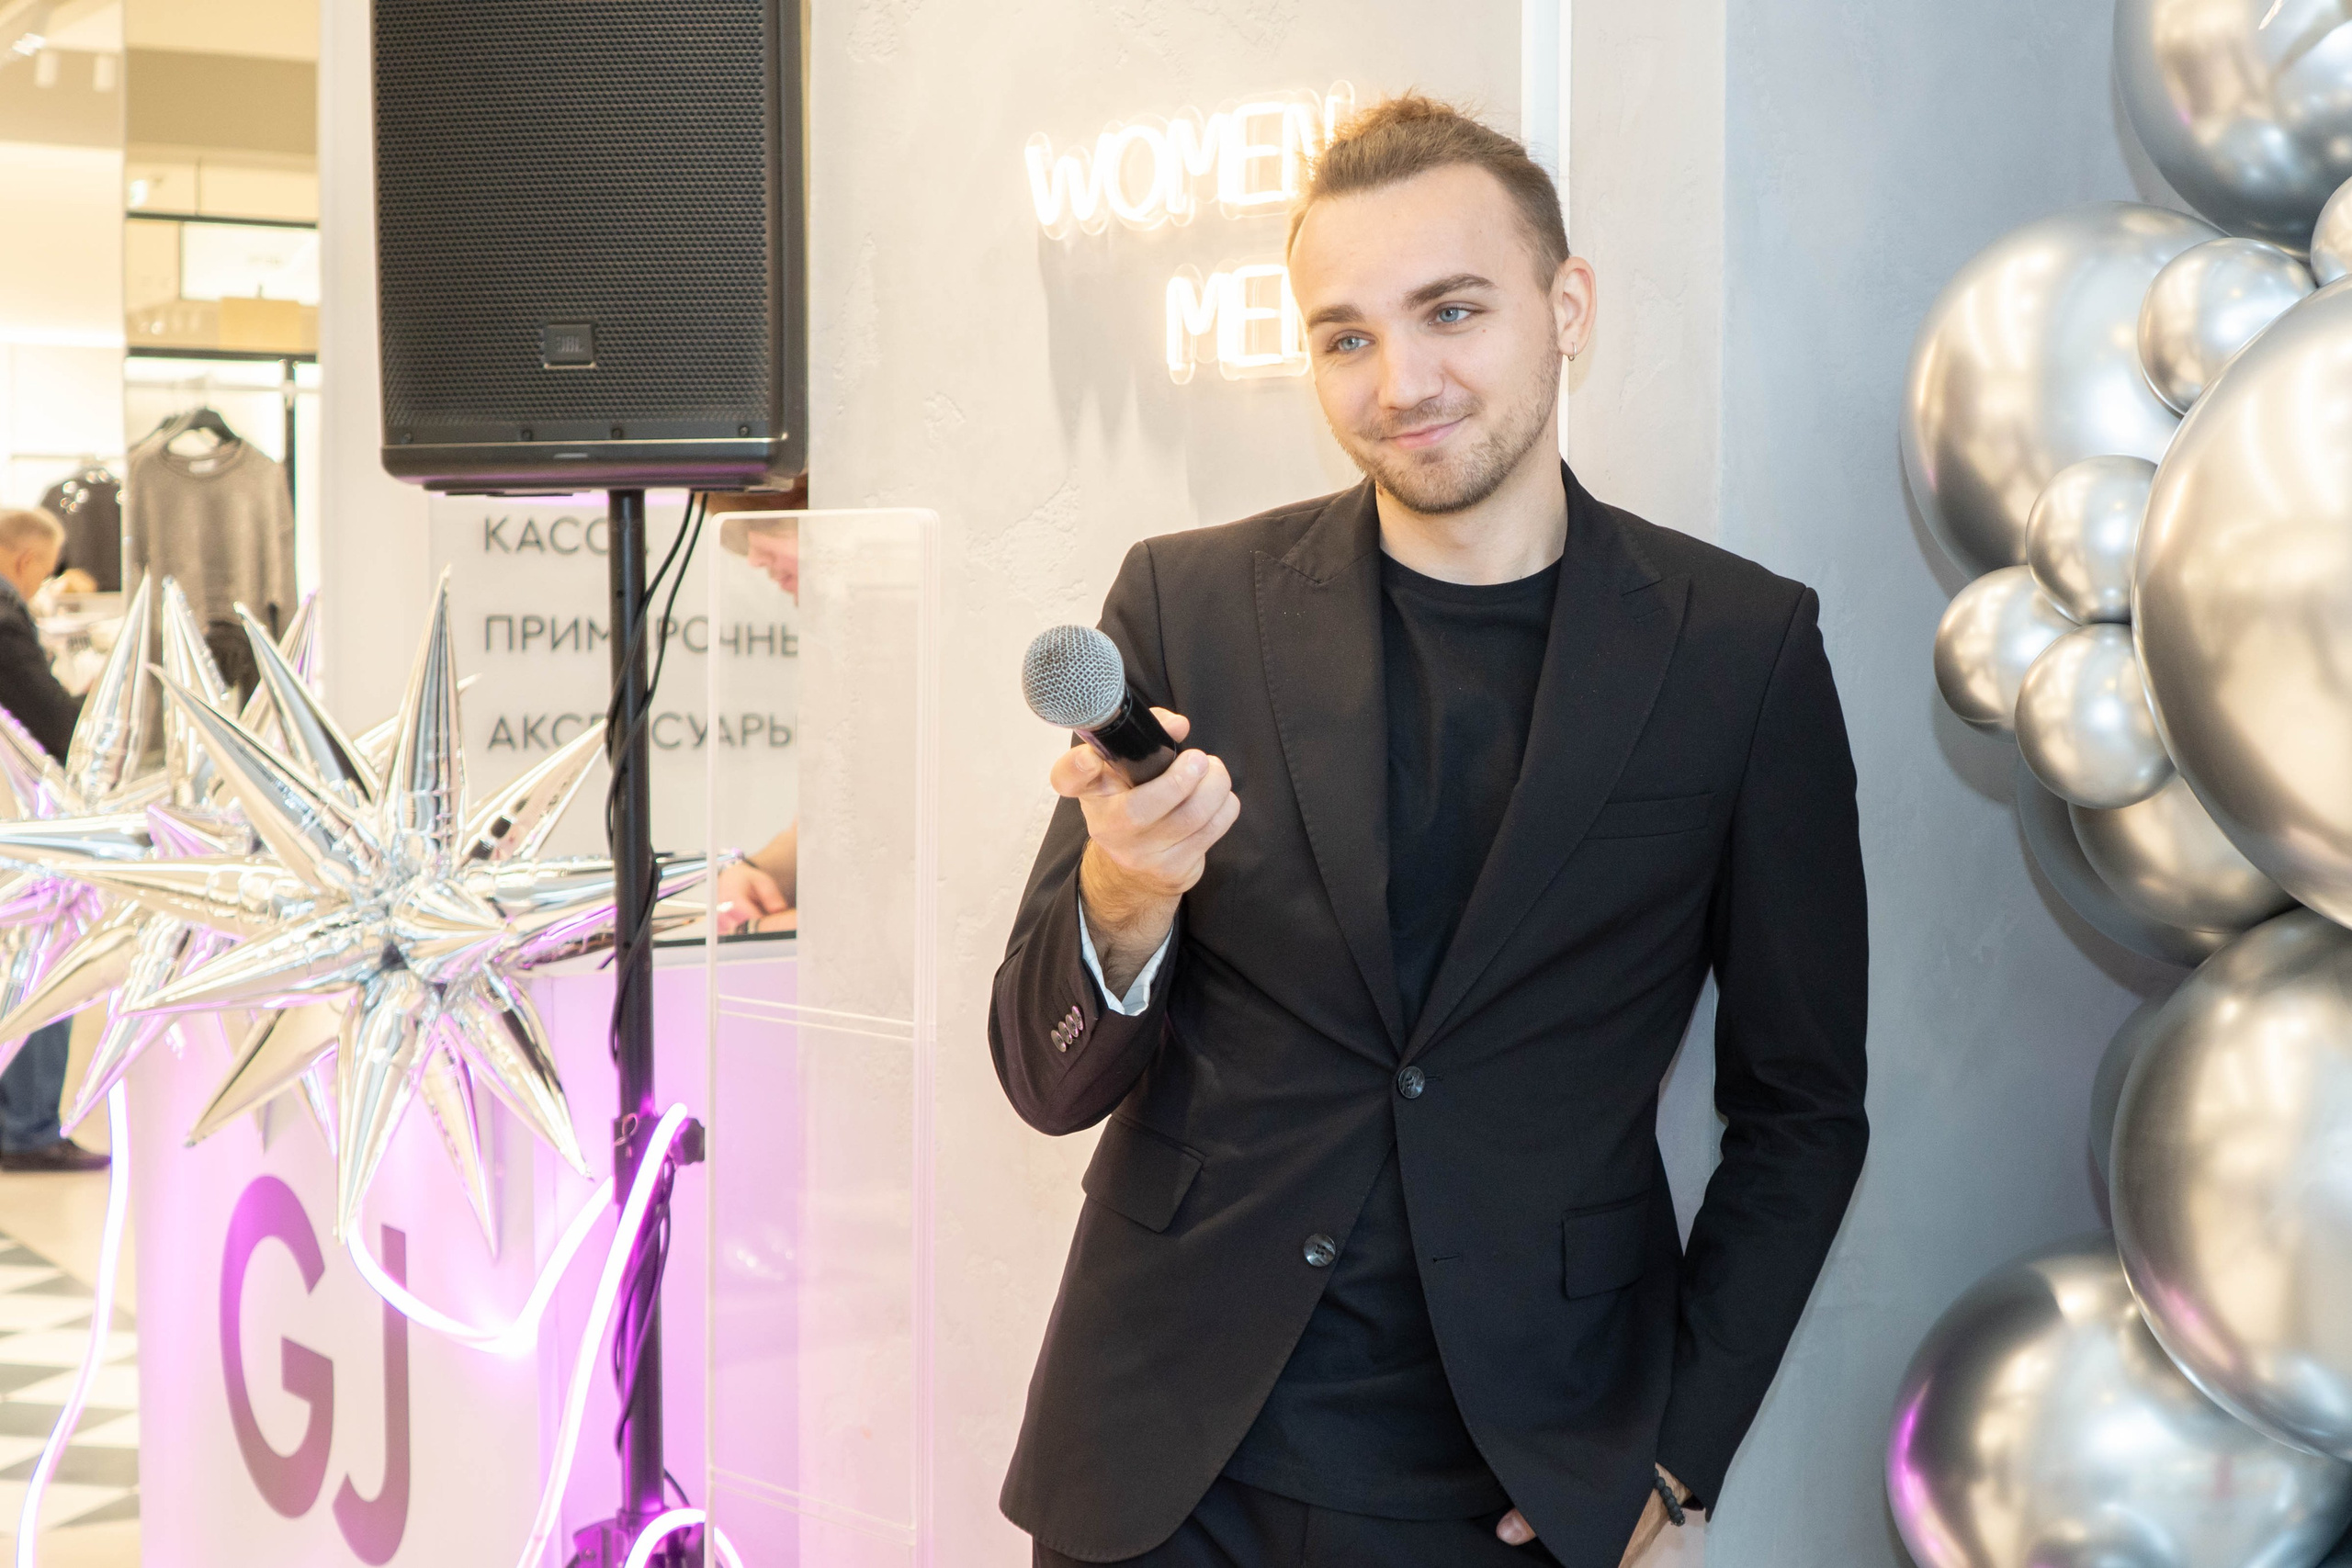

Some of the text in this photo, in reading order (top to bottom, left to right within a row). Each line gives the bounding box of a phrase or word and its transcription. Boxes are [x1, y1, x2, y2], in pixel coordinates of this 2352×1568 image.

[1023, 84, 1347, 232] WOMEN
[485, 515, 649, 556] КАСС
[488, 710, 798, 750] АКССУАРЫ
[220, 1173, 411, 1567] GJ
